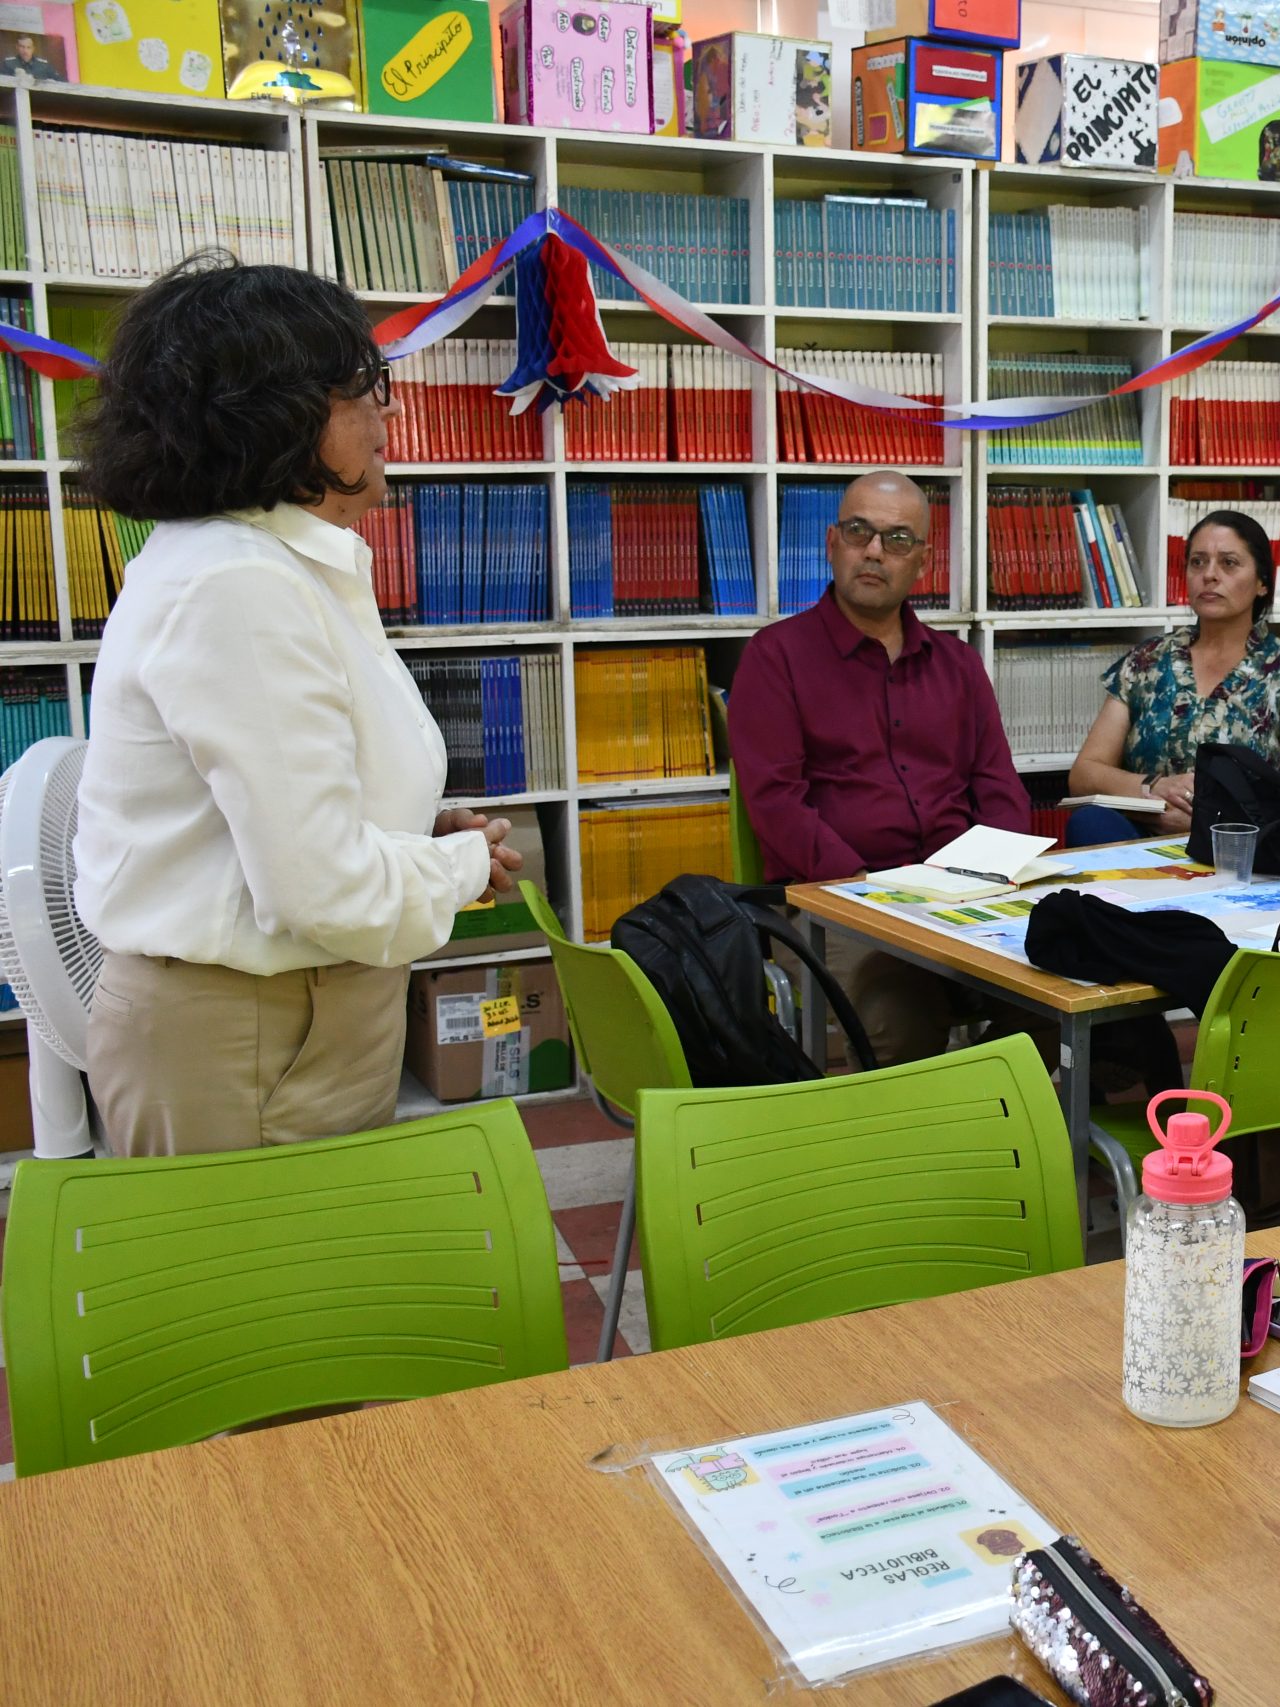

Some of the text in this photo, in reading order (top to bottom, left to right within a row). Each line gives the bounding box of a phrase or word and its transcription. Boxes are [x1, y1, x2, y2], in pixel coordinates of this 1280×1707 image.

[559, 12, 569, 31] Año
[600, 15, 609, 42] Autor
[384, 15, 463, 96] El Principito
[625, 29, 638, 59] Datos
[1225, 34, 1266, 48] Opinión
[1072, 73, 1102, 104] EL
[1065, 64, 1159, 161] PRINCIPITO
[509, 1047, 521, 1079] SILS
[820, 1526, 864, 1540] Biblioteca
[840, 1548, 939, 1580] BIBLIOTECA
[883, 1560, 951, 1585] REGLAS
